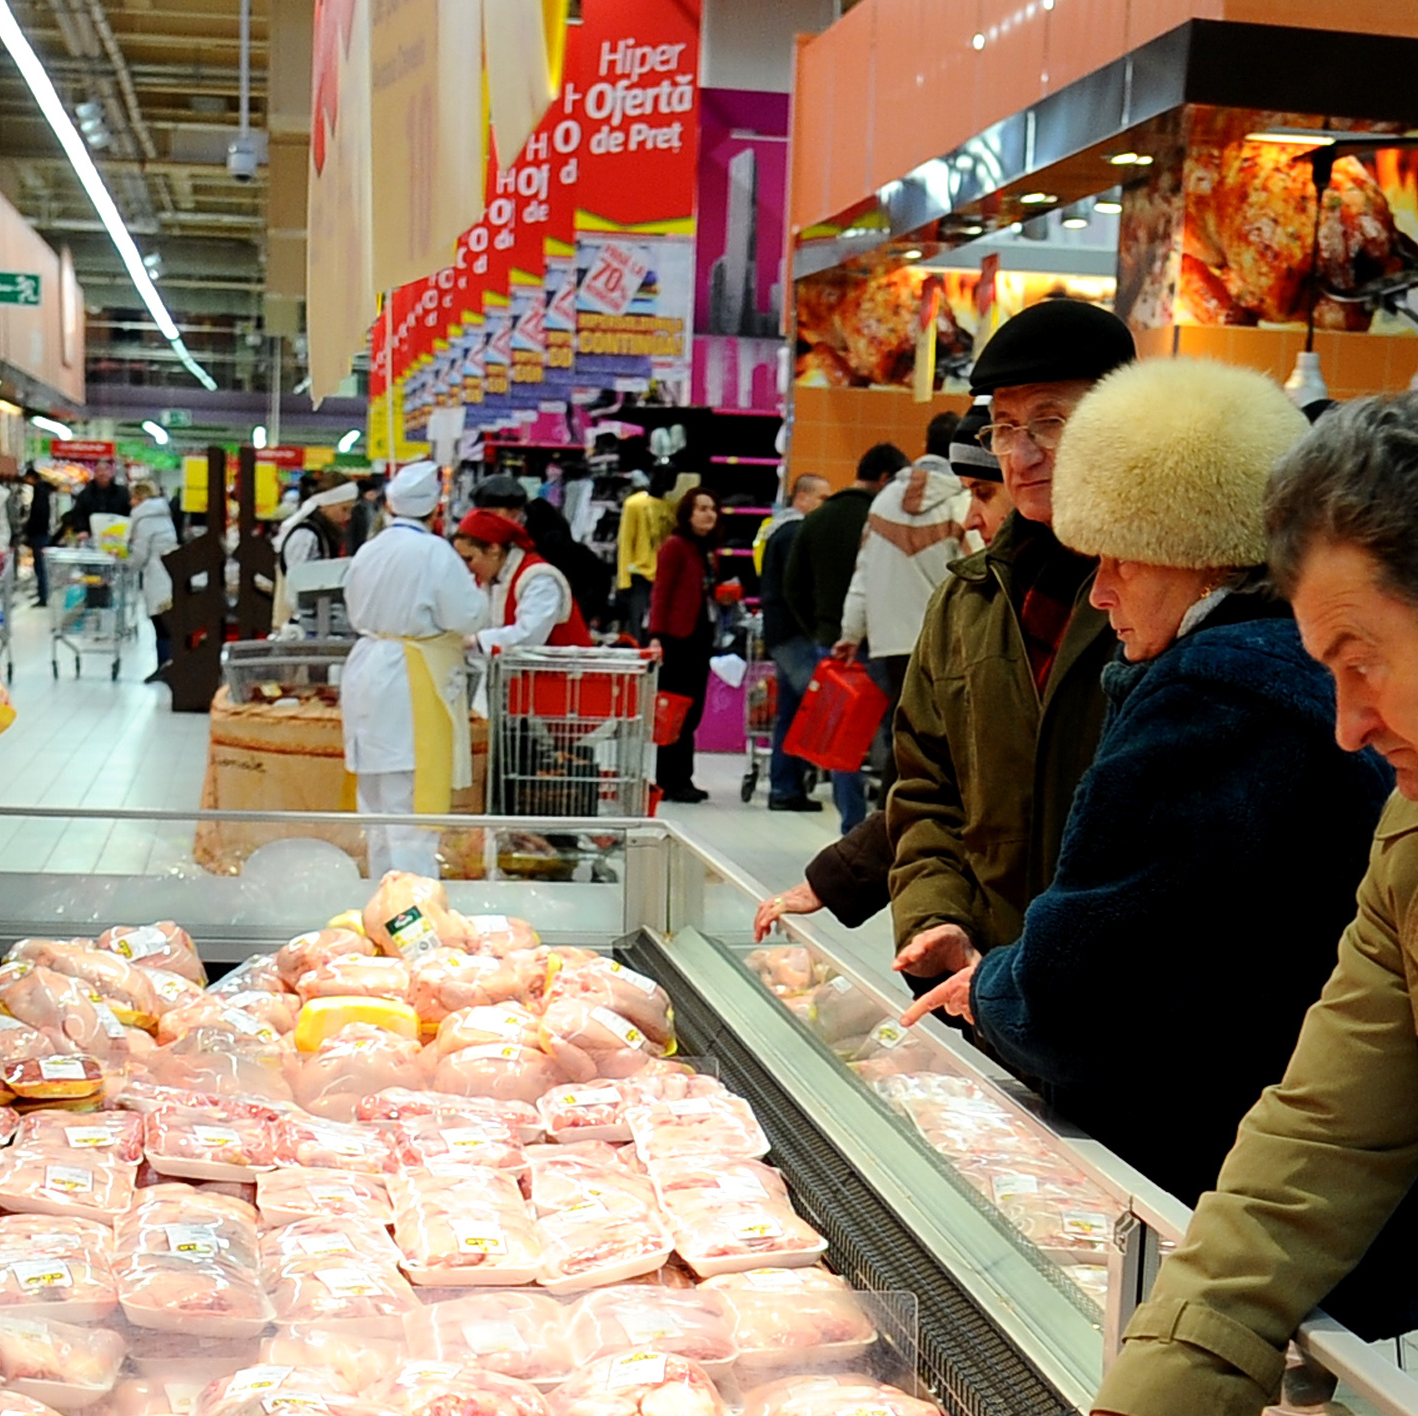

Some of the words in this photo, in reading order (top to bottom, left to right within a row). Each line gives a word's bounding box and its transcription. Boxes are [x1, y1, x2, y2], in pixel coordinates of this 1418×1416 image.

[599, 38, 687, 82] Hiper
[585, 74, 693, 126] Ofertă
[589, 125, 625, 154] de
